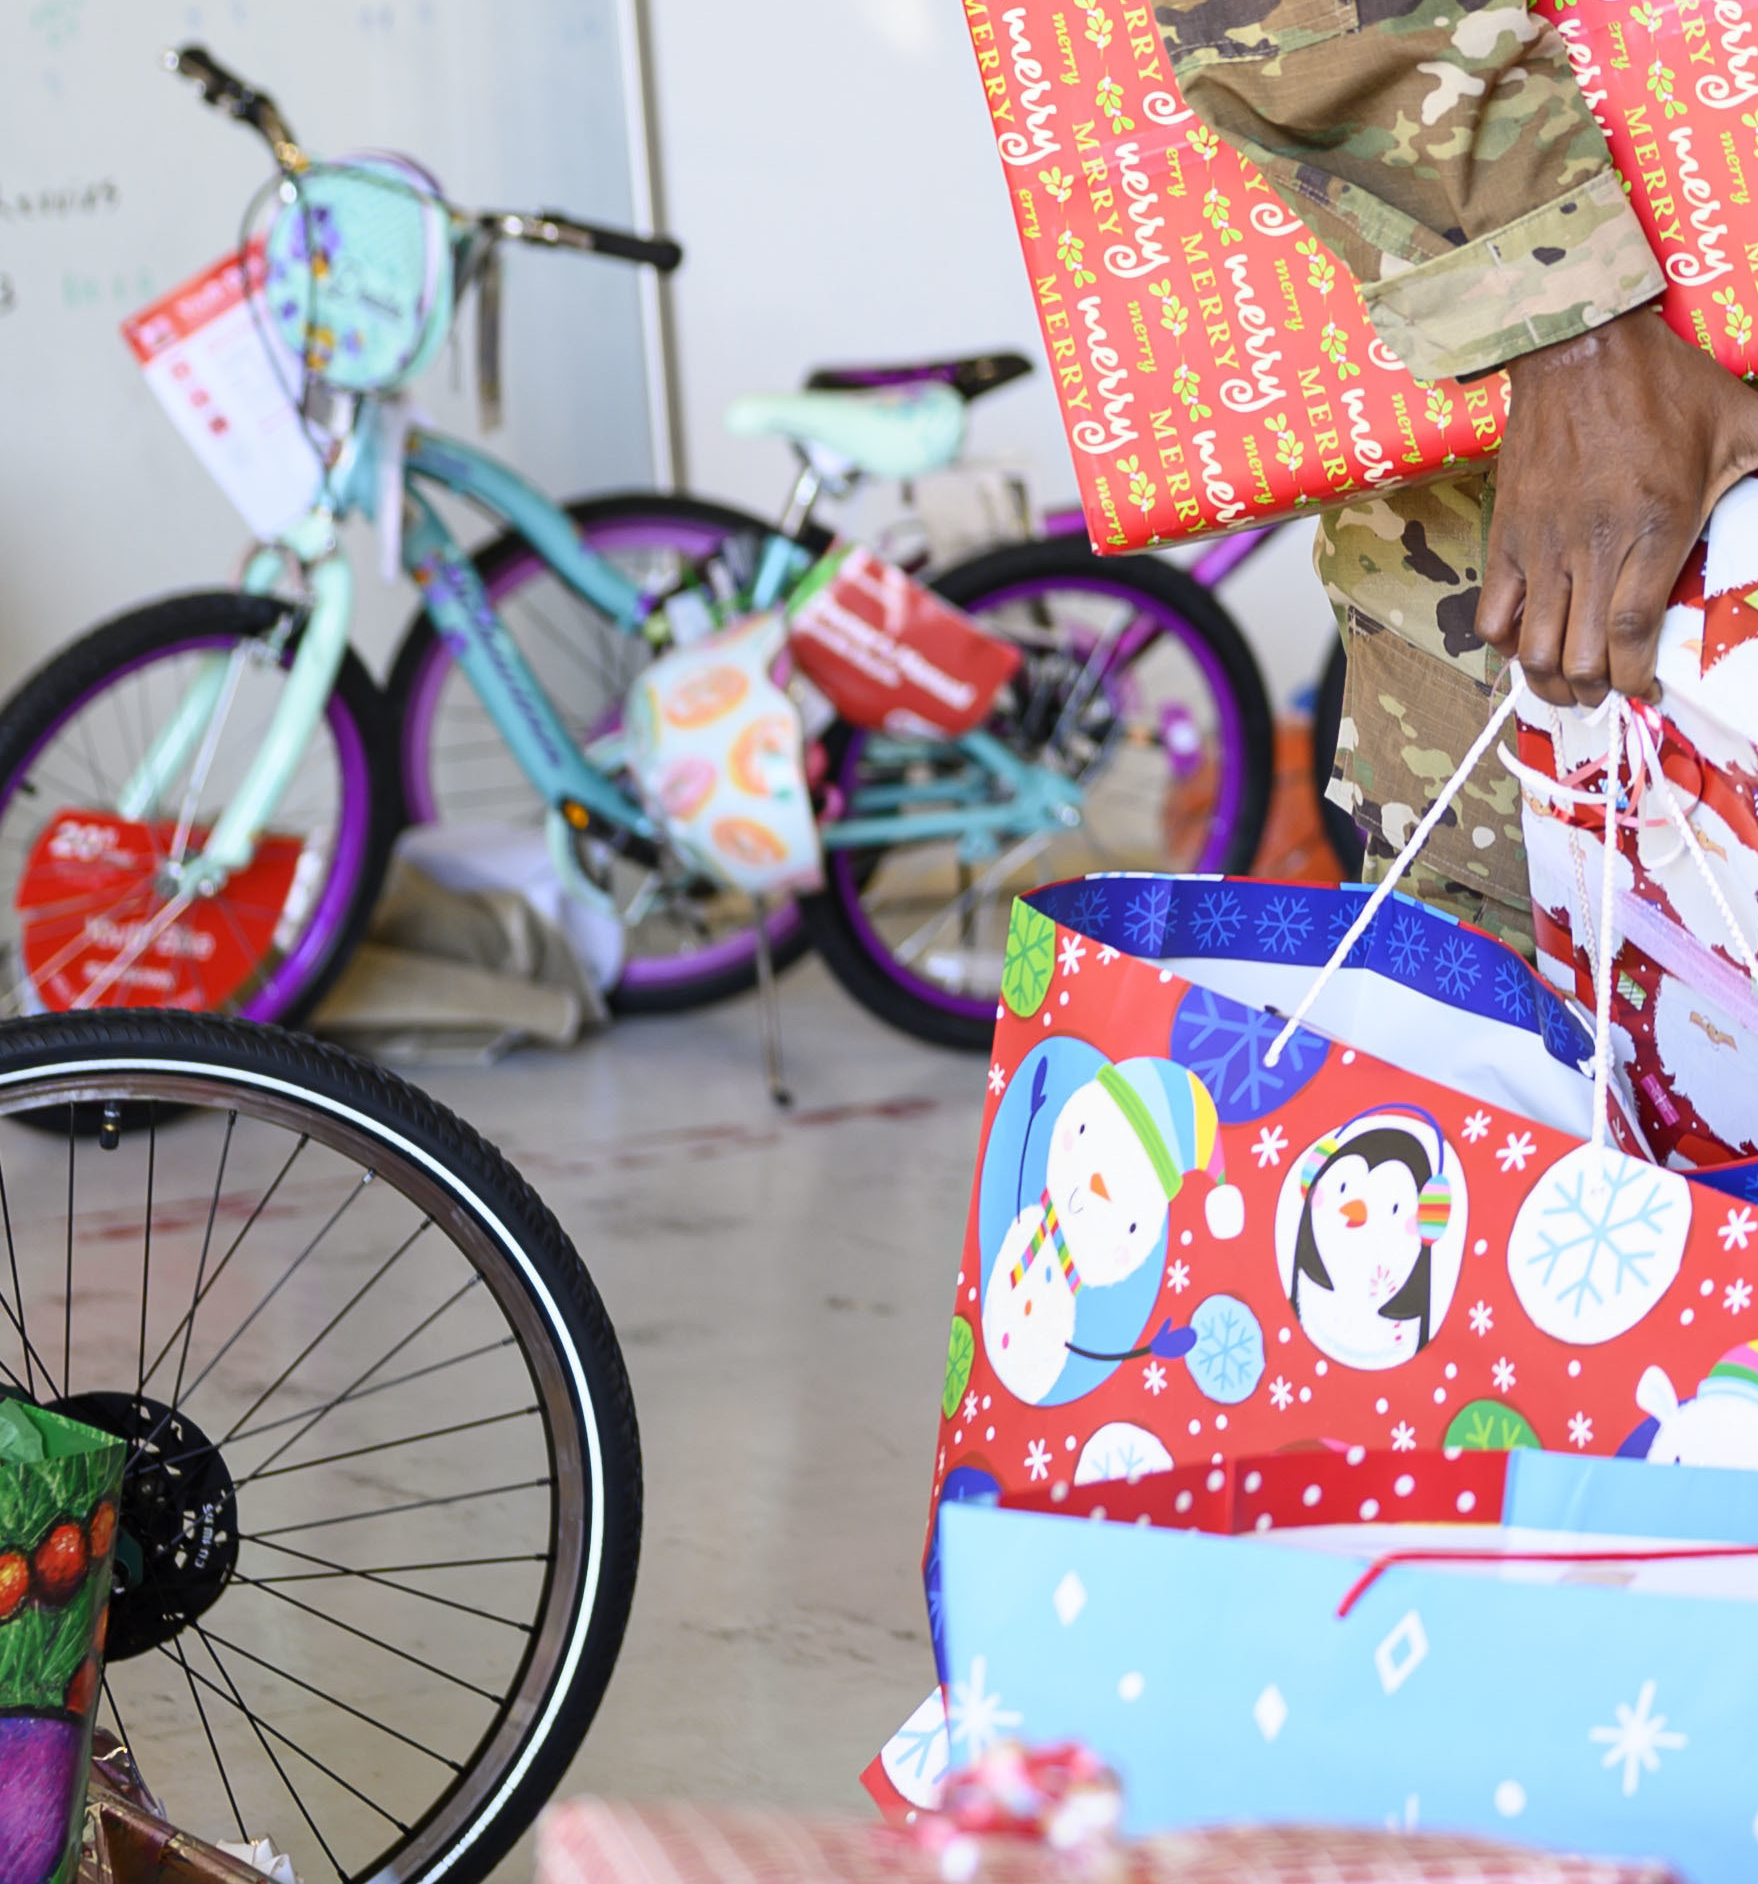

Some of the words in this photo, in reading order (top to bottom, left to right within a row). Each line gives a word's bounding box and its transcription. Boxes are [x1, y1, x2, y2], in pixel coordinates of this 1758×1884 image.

[997, 7, 1061, 166] merry
[1052, 12, 1081, 86] merry
[1624, 104, 1686, 245] MERRY
[1665, 126, 1734, 287] merry
[1719, 131, 1751, 206] merry
[1036, 273, 1092, 411] MERRY
[1127, 300, 1157, 374] merry
[1181, 231, 1241, 371] MERRY
[1220, 253, 1287, 412] merry
[1274, 258, 1305, 332] merry
[1072, 295, 1138, 454] merry
[1298, 364, 1362, 495] MERRY
[1391, 392, 1424, 466] merry
[1095, 476, 1128, 547] merry
[1150, 407, 1209, 534] MERRY
[1243, 434, 1276, 505] merry
